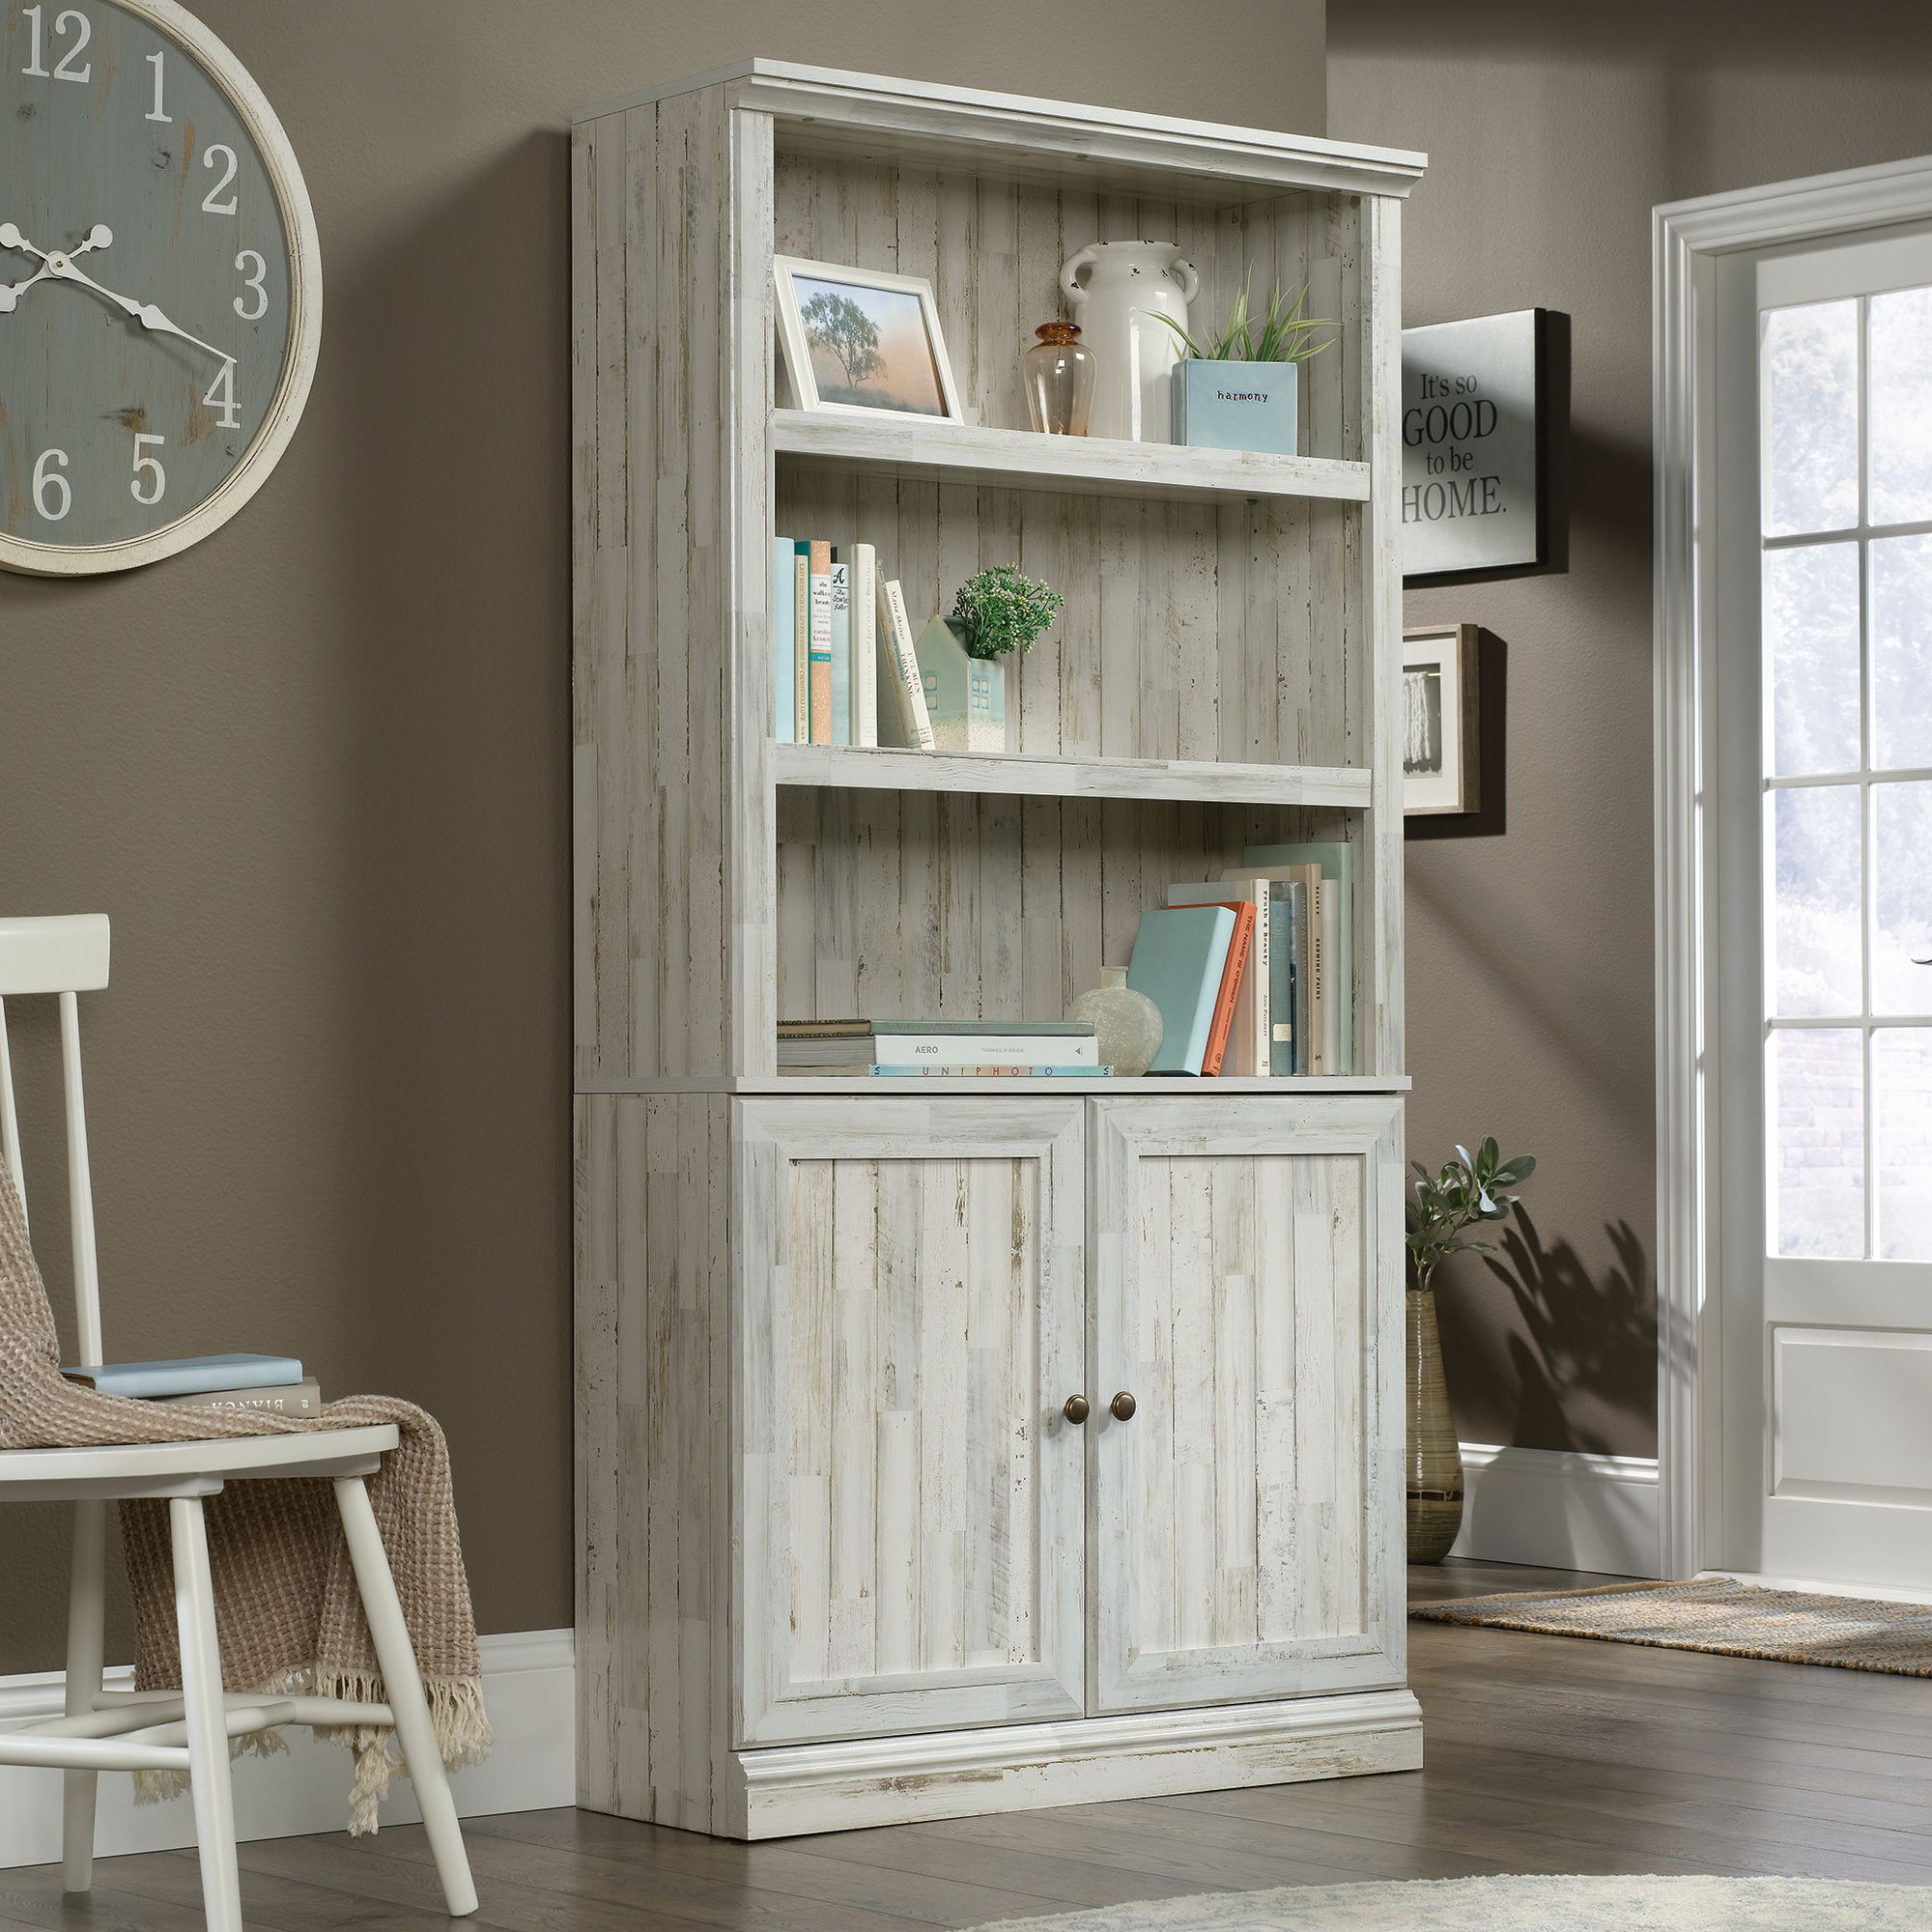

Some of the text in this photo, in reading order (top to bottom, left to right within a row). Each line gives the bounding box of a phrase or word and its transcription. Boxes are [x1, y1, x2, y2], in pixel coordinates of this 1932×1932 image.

[21, 4, 92, 83] 12
[144, 51, 173, 123] 1
[201, 144, 239, 215] 2
[233, 250, 268, 320] 3
[202, 358, 242, 429] 4
[1216, 390, 1268, 404] harmony
[1420, 374, 1478, 400] It's so
[1402, 399, 1497, 446] GOOD
[130, 433, 165, 505] 5
[1426, 446, 1474, 474] to be
[32, 448, 71, 520] 6
[1402, 475, 1508, 524] HOME.
[833, 572, 845, 584] A
[1239, 934, 1249, 957] NAME
[1244, 915, 1253, 932] THE
[1237, 959, 1243, 969] IS
[923, 1066, 1053, 1075] UNIPHOTO
